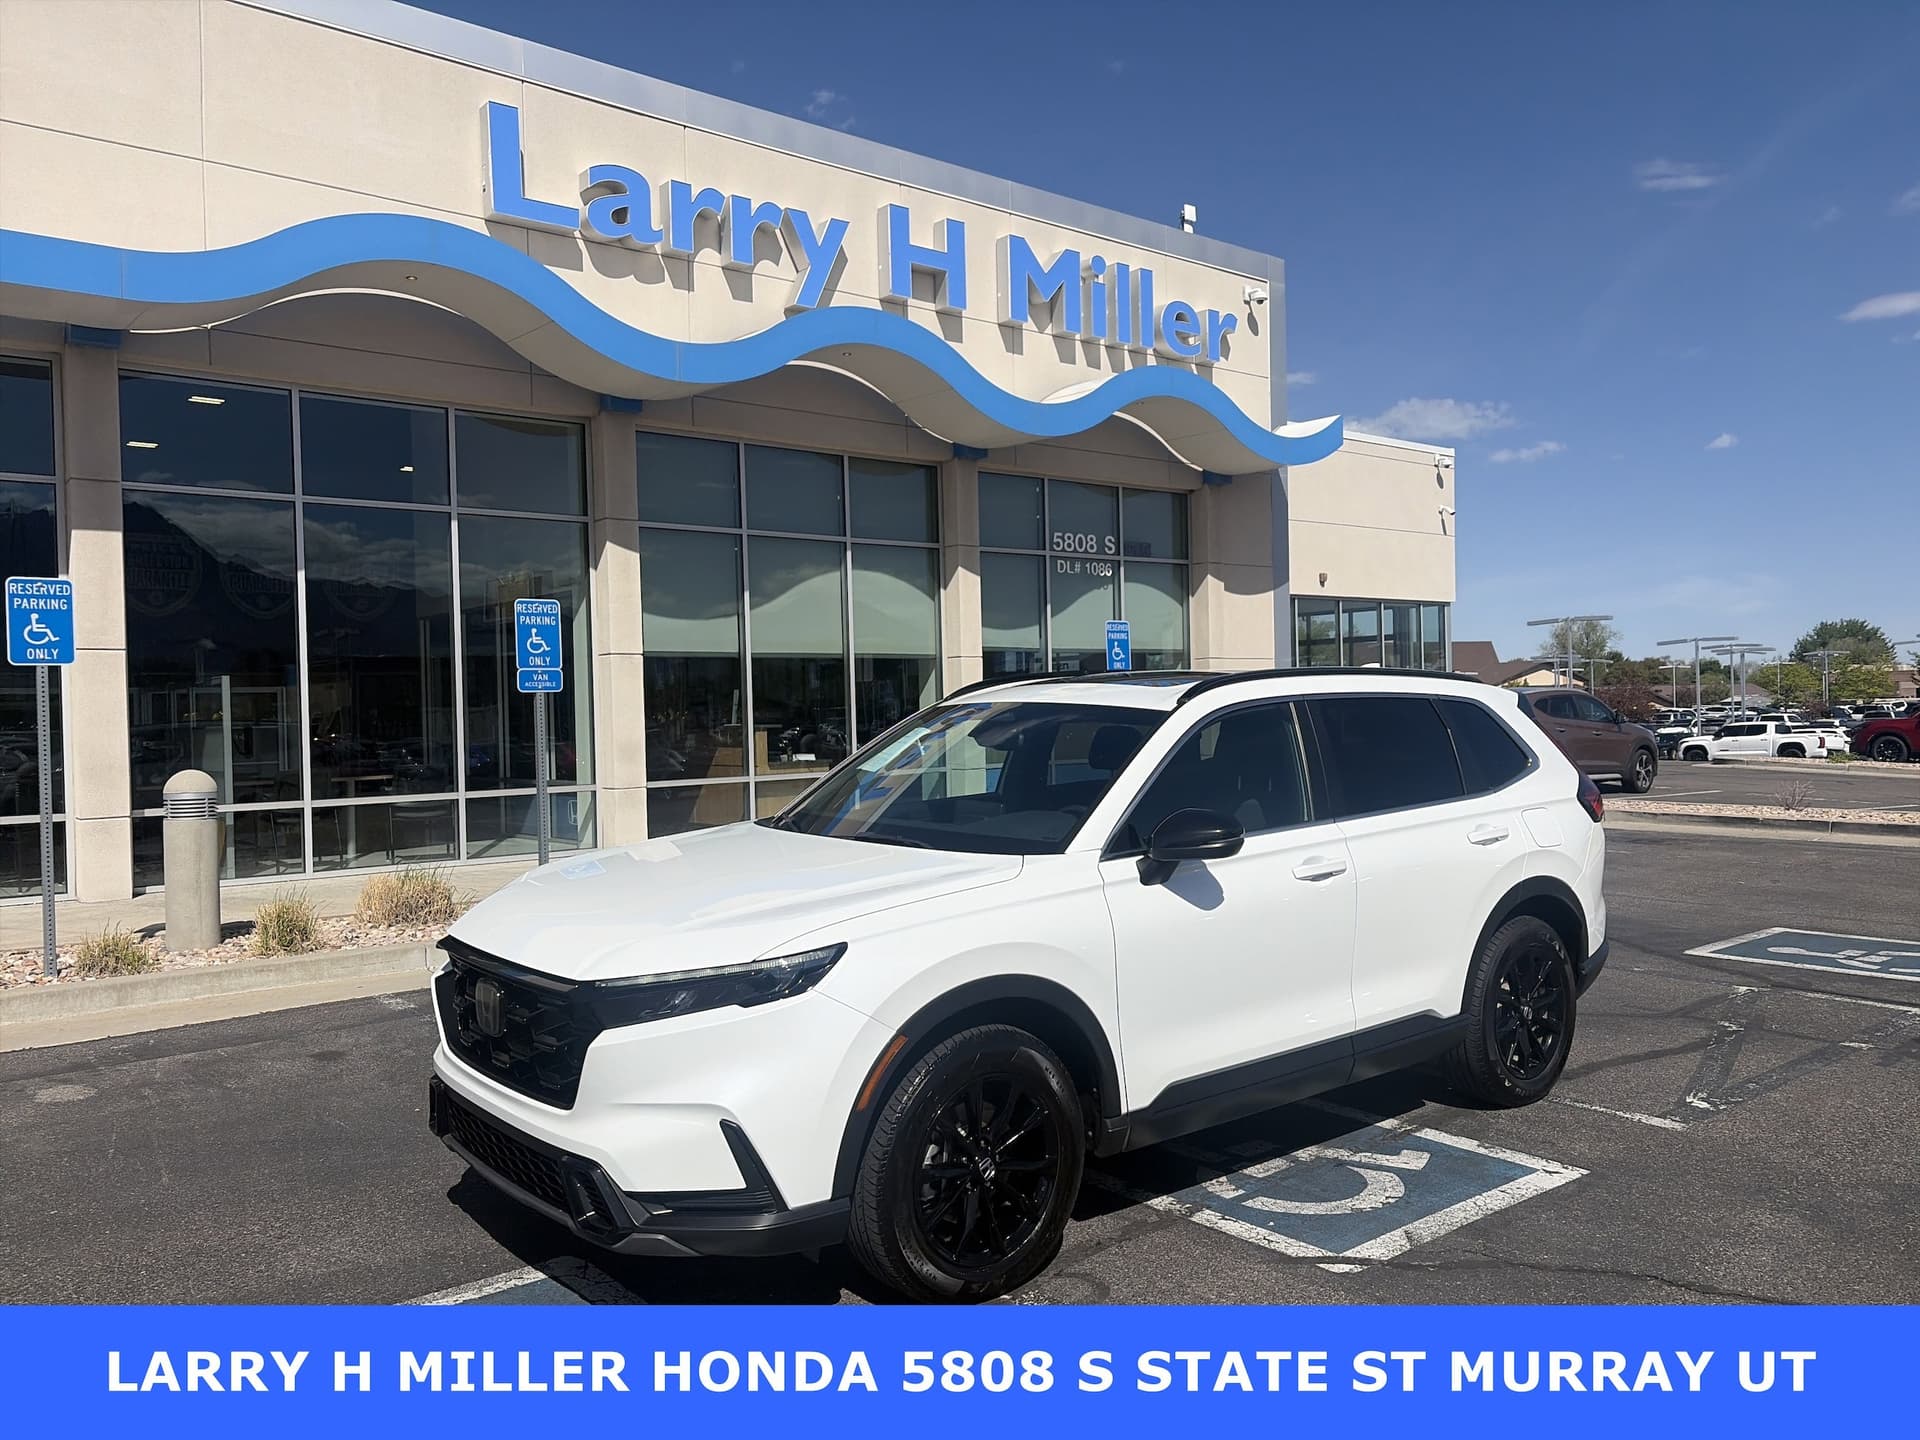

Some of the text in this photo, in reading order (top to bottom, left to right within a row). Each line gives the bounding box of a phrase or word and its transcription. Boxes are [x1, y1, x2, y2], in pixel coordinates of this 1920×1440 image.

[482, 100, 1239, 363] Larry H Miller
[1053, 532, 1116, 554] 5808 S
[1057, 560, 1112, 576] DL# 1086
[9, 583, 71, 595] RESERVED
[13, 598, 68, 610] PARKING
[517, 603, 558, 613] RESERVED
[520, 616, 556, 625] PARKING
[26, 648, 59, 660] ONLY
[528, 656, 551, 666] ONLY
